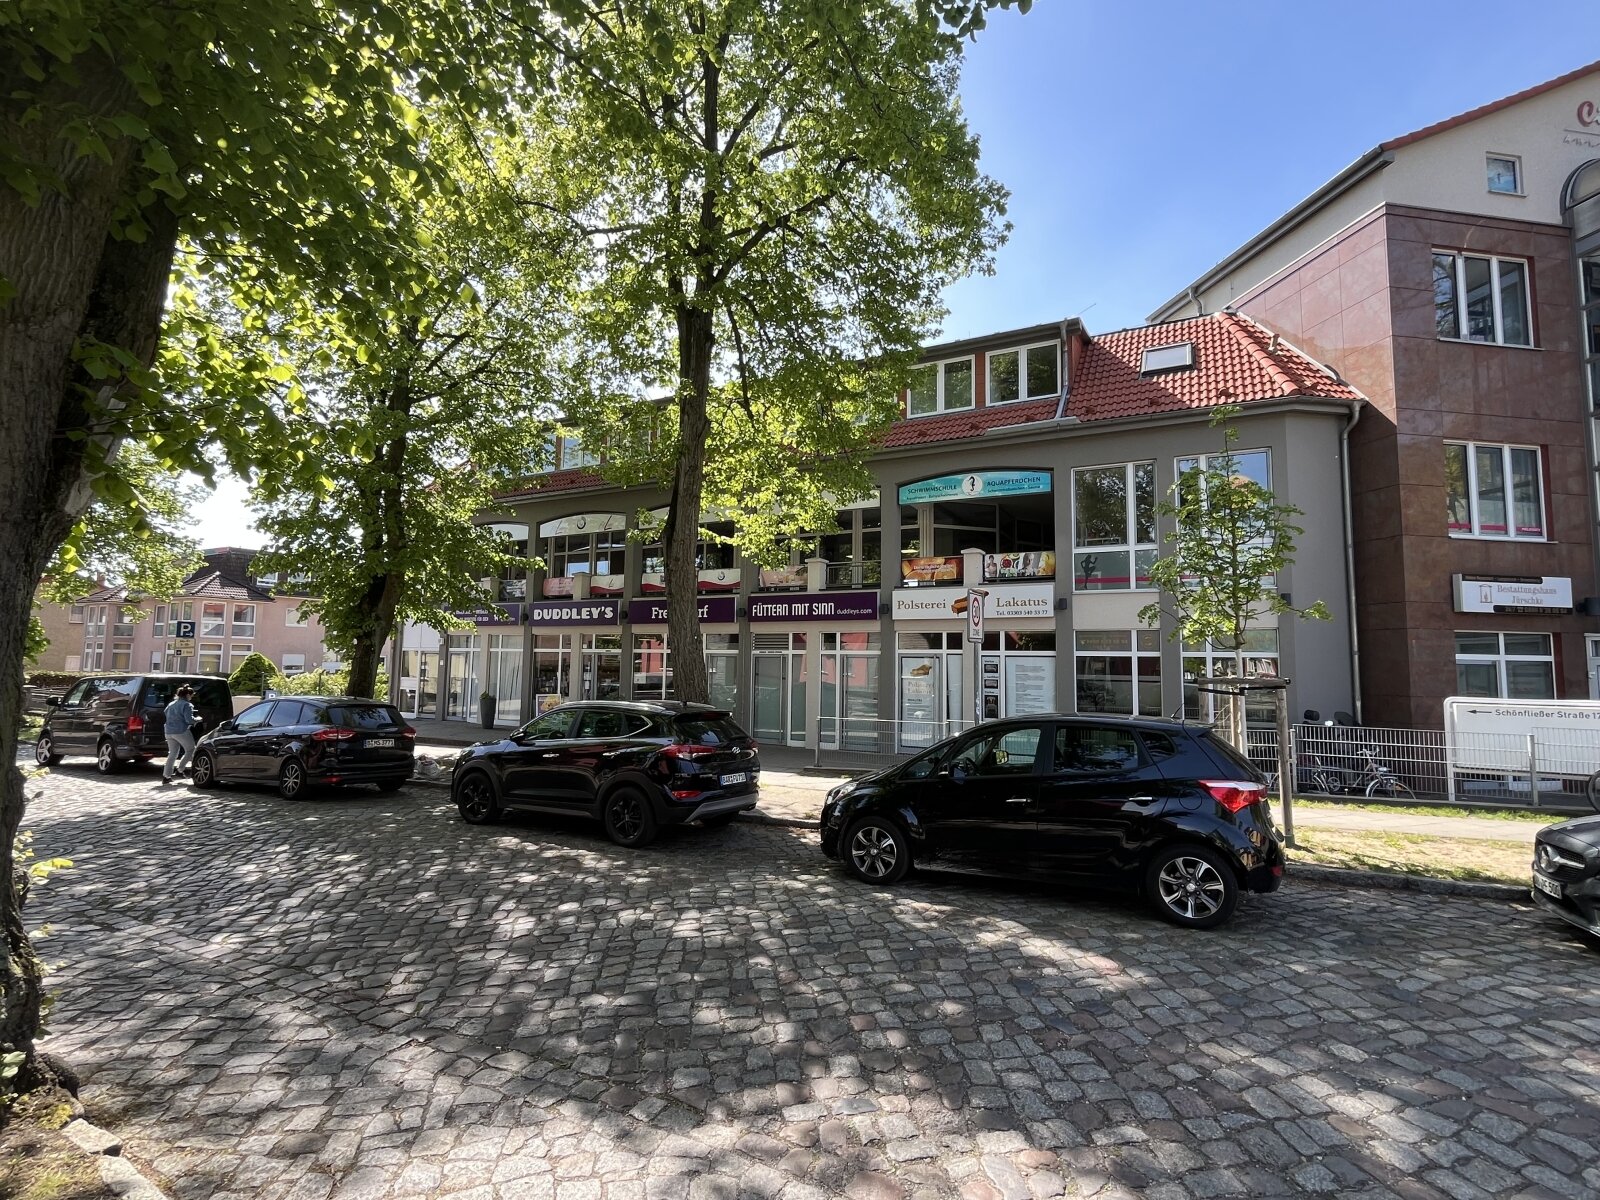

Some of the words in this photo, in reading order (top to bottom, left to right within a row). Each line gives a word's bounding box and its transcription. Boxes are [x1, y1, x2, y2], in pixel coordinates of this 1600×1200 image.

[907, 484, 957, 495] SCHWIMMSCHULE
[752, 602, 789, 617] FÜTTERN
[791, 603, 810, 616] MIT
[812, 602, 835, 616] SINN
[897, 598, 946, 610] Polsterei
[996, 597, 1048, 608] Lakatus
[533, 606, 614, 621] DUDDLEY'S
[180, 623, 192, 637] P
[1495, 708, 1555, 718] Schönfließer
[1556, 710, 1591, 720] Straße
